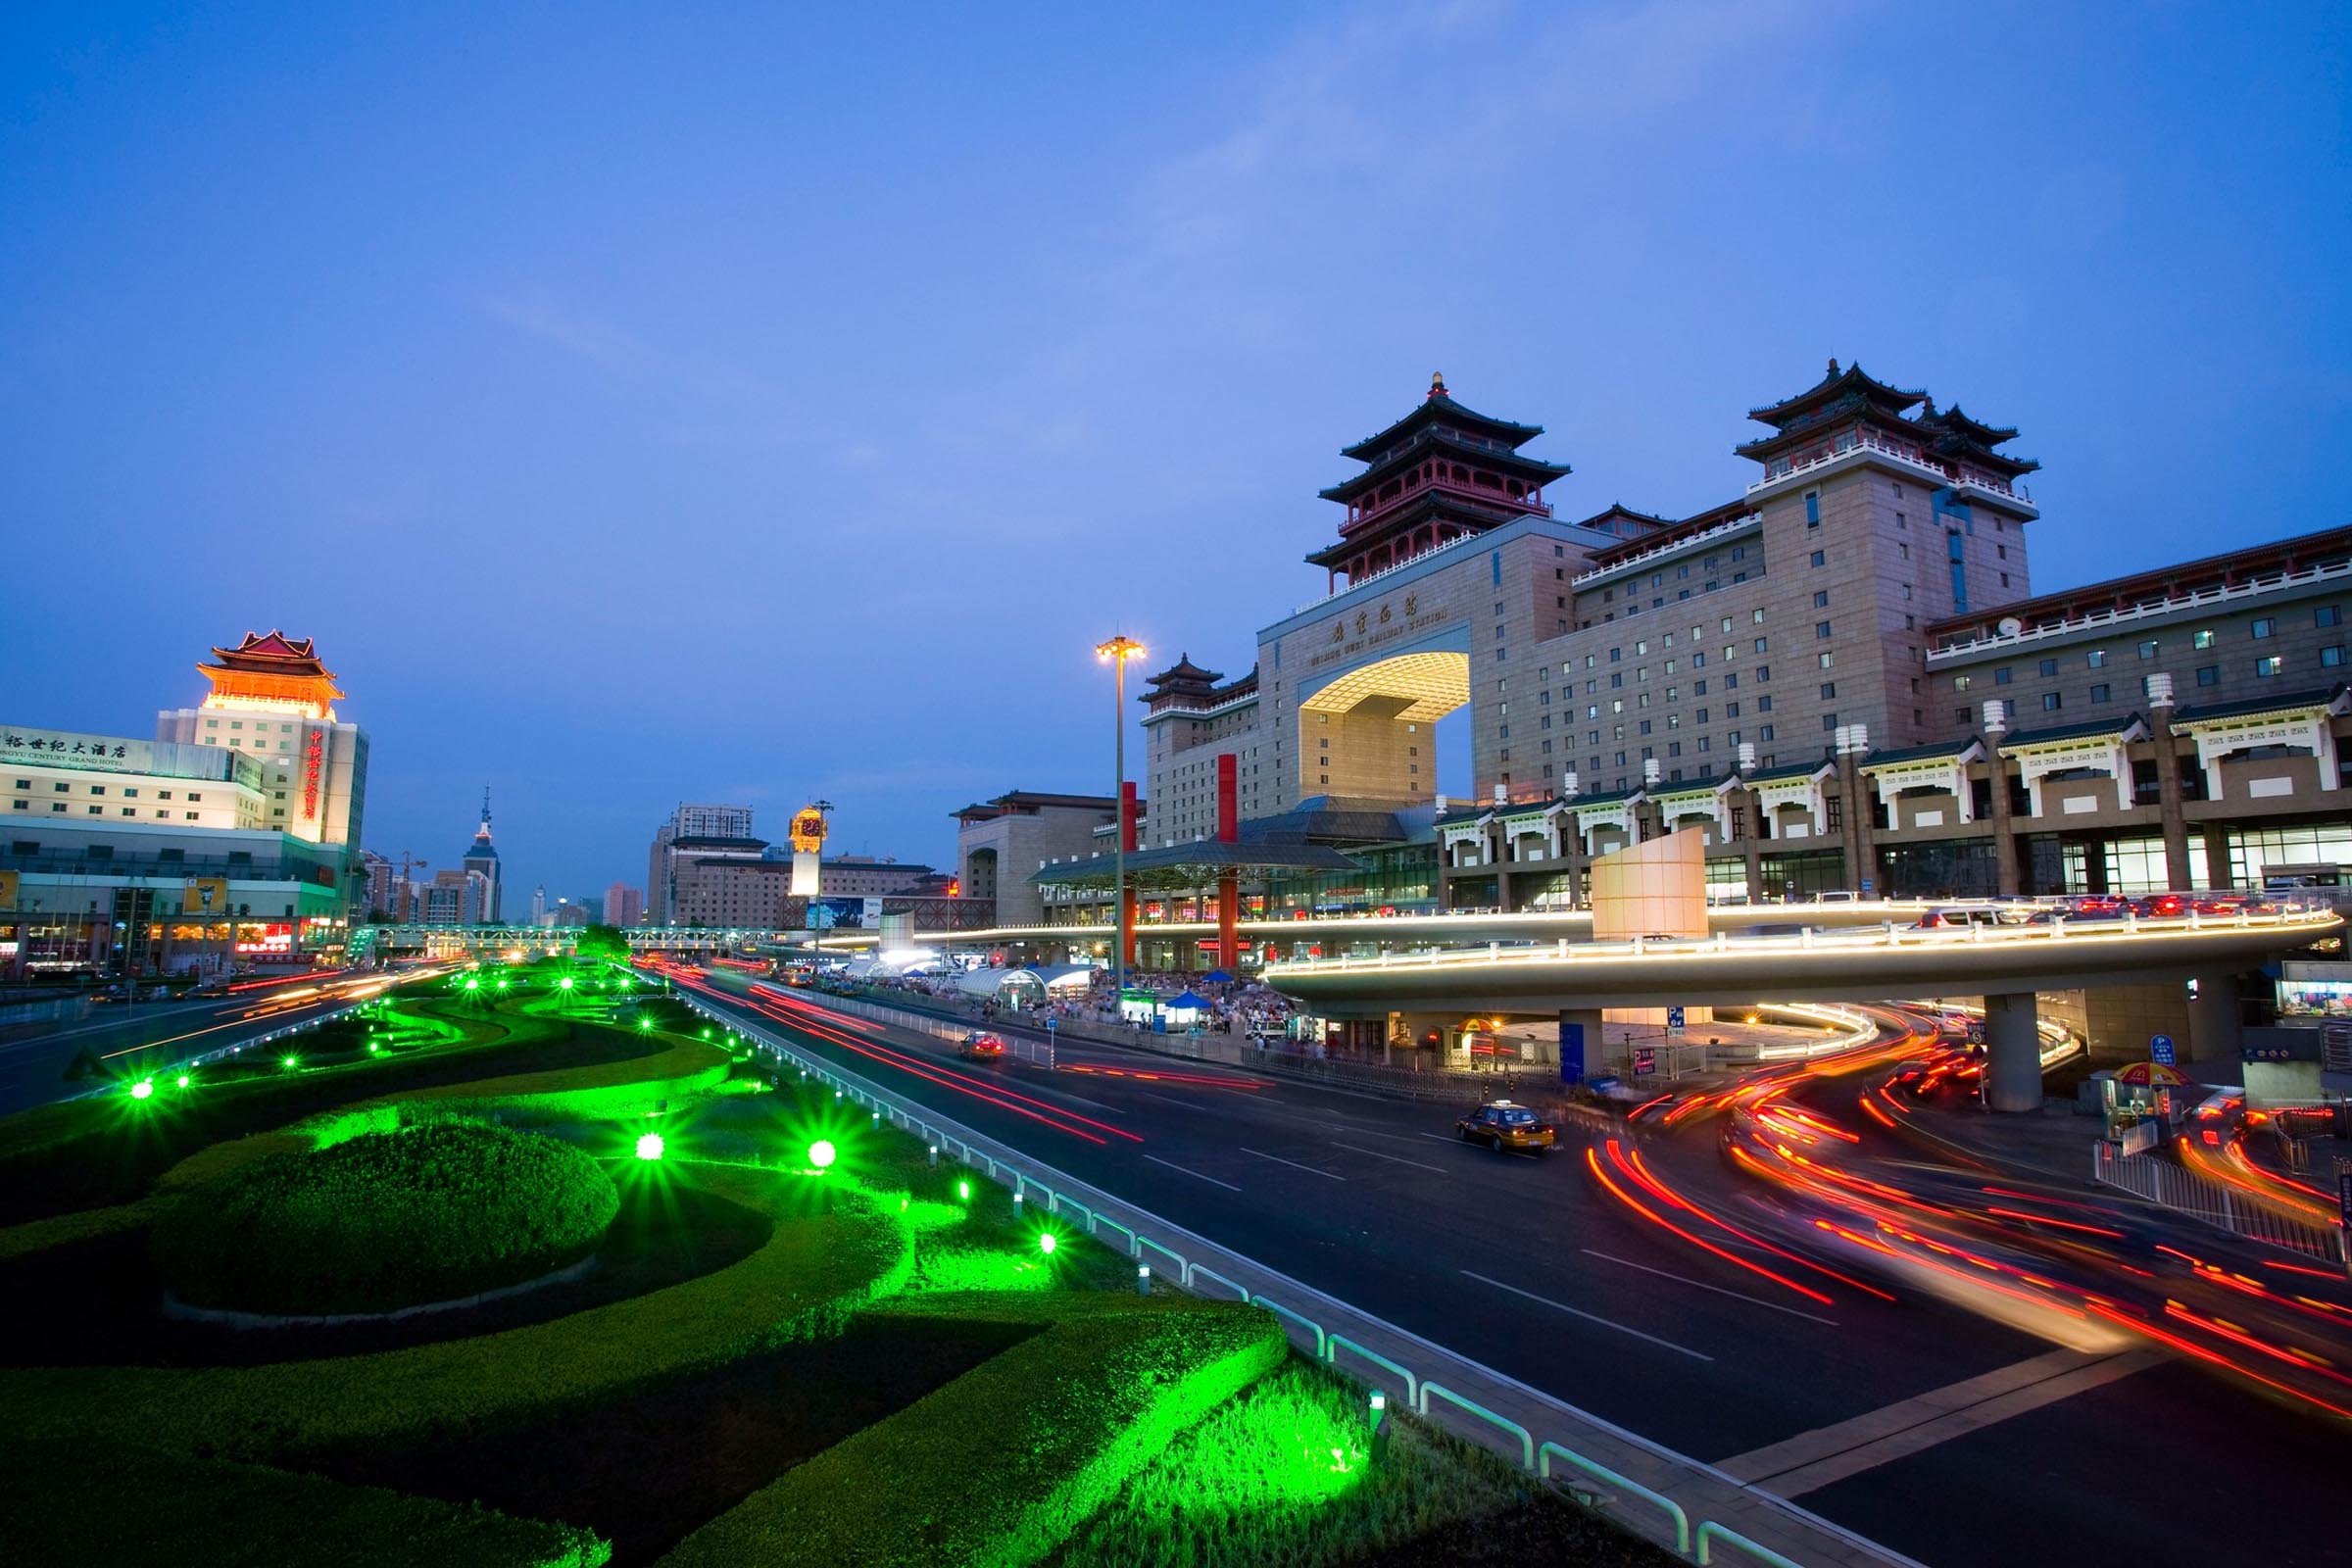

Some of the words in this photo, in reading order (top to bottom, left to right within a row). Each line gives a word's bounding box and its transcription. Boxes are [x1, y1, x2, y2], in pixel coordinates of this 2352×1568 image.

[0, 734, 126, 759] 裕世纪大酒店
[28, 753, 67, 761] CENTURY
